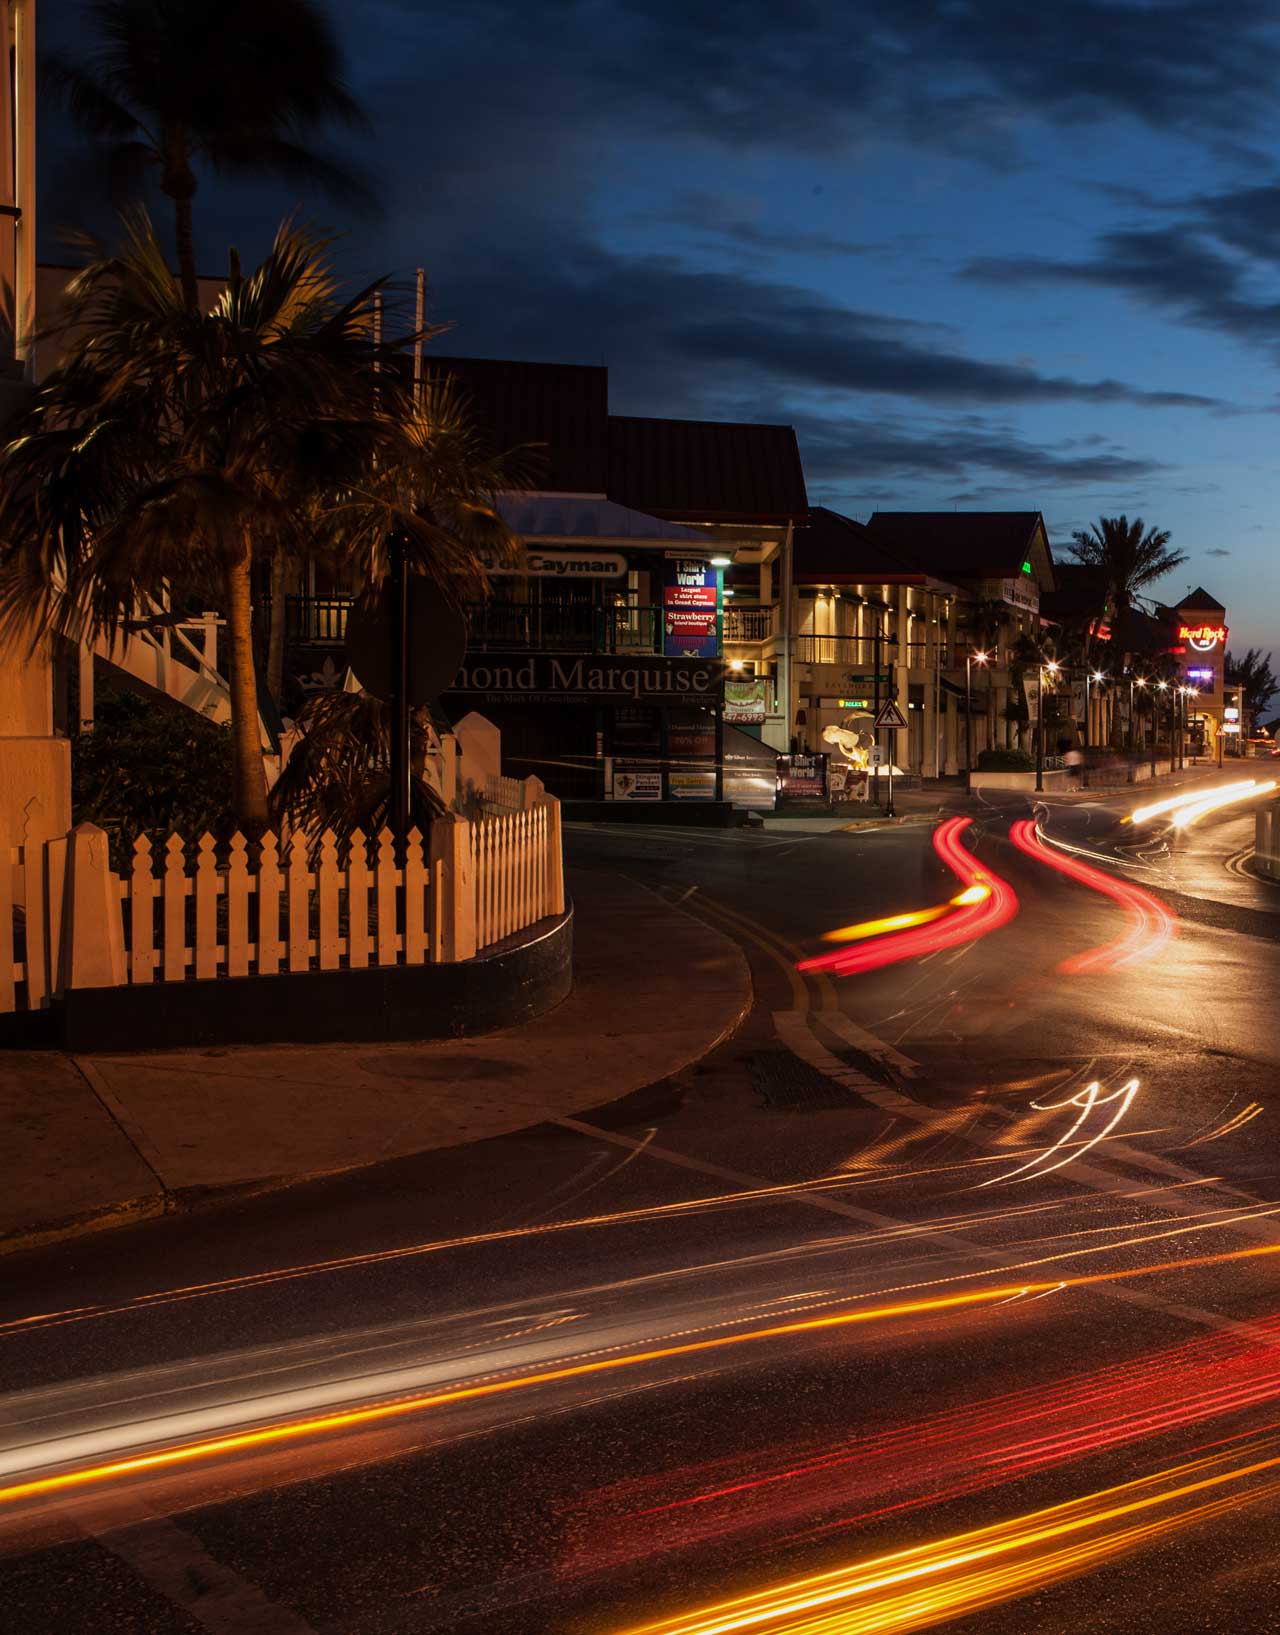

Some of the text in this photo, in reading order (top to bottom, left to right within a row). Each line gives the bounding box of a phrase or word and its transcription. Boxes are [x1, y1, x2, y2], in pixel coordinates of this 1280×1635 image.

[527, 555, 618, 574] Cayman
[677, 573, 705, 586] World
[668, 612, 715, 622] Strawberry
[1179, 627, 1225, 641] Hard Rock
[548, 658, 710, 699] Marquise
[844, 700, 862, 708] ROLEX
[794, 755, 816, 767] Shirt
[789, 767, 816, 778] World
